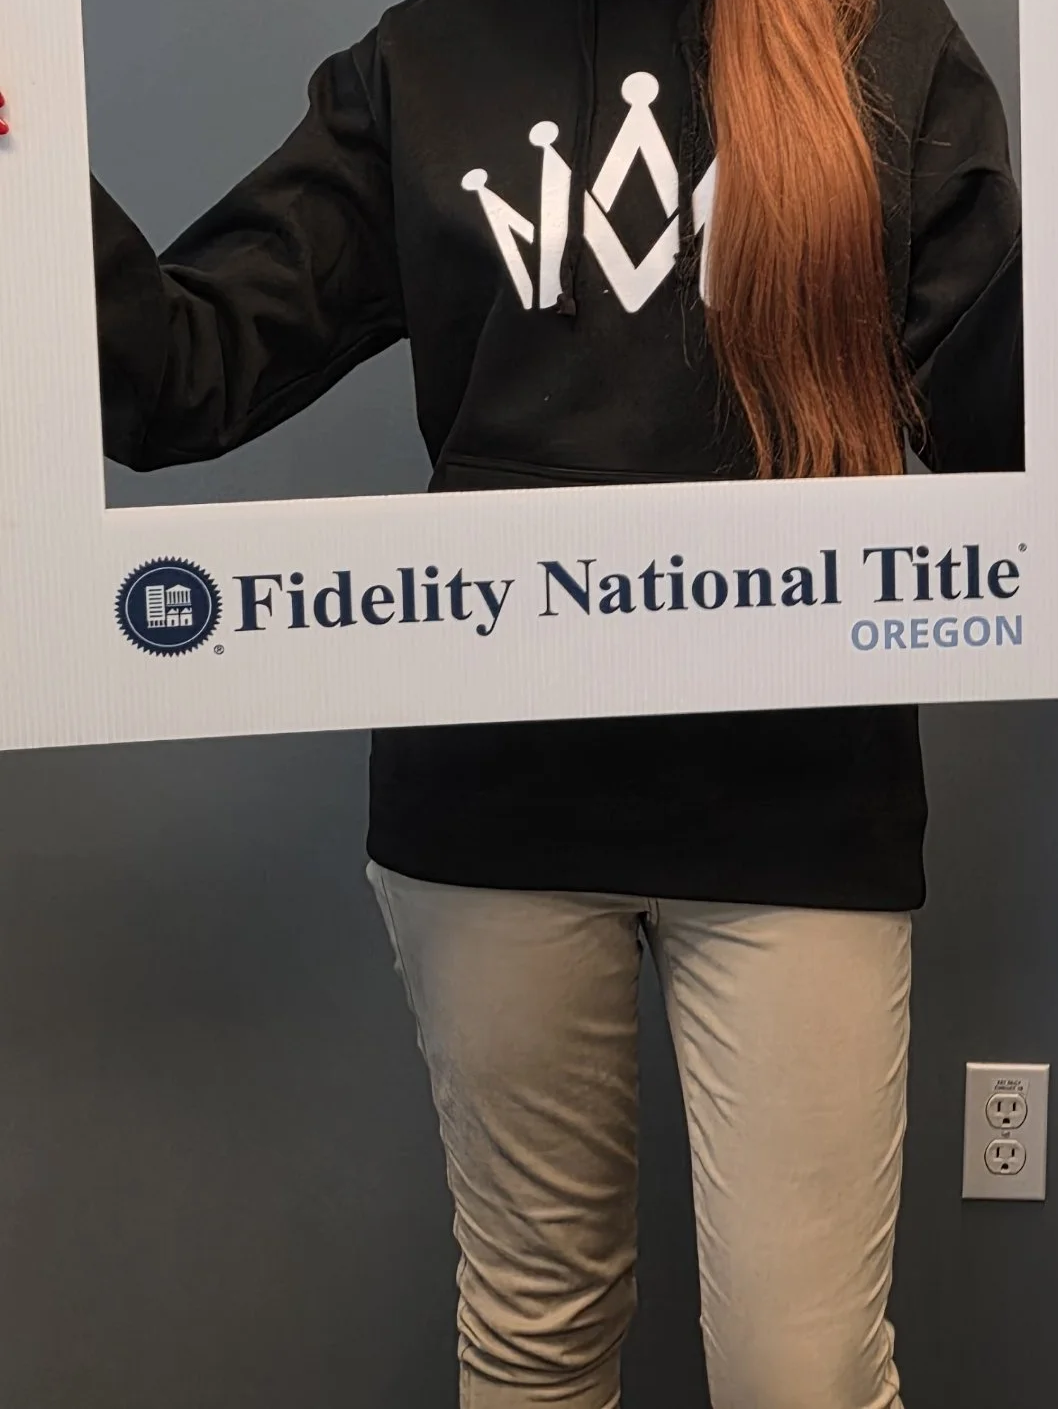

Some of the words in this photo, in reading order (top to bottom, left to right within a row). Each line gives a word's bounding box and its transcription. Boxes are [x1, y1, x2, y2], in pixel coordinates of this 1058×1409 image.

[232, 565, 516, 637] Fidelity
[536, 549, 842, 617] National
[850, 614, 1024, 652] OREGON
